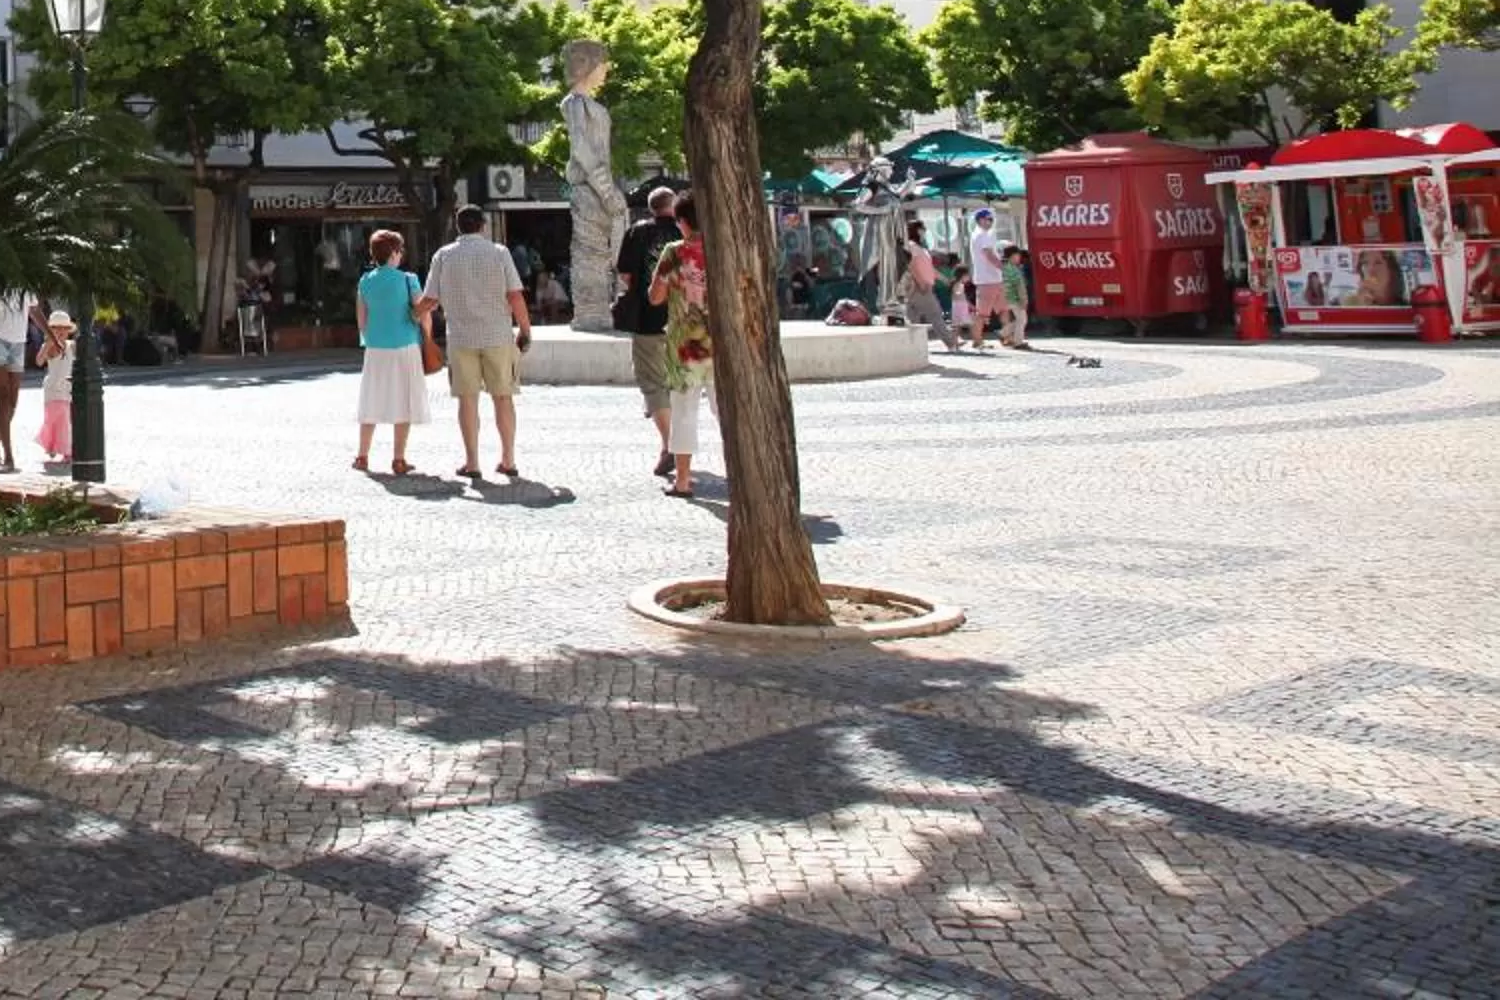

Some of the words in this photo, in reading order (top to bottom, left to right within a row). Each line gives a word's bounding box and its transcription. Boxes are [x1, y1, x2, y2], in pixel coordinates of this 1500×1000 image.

[1036, 203, 1111, 228] SAGRES
[1155, 208, 1216, 239] SAGRES
[1057, 251, 1115, 269] SAGRES
